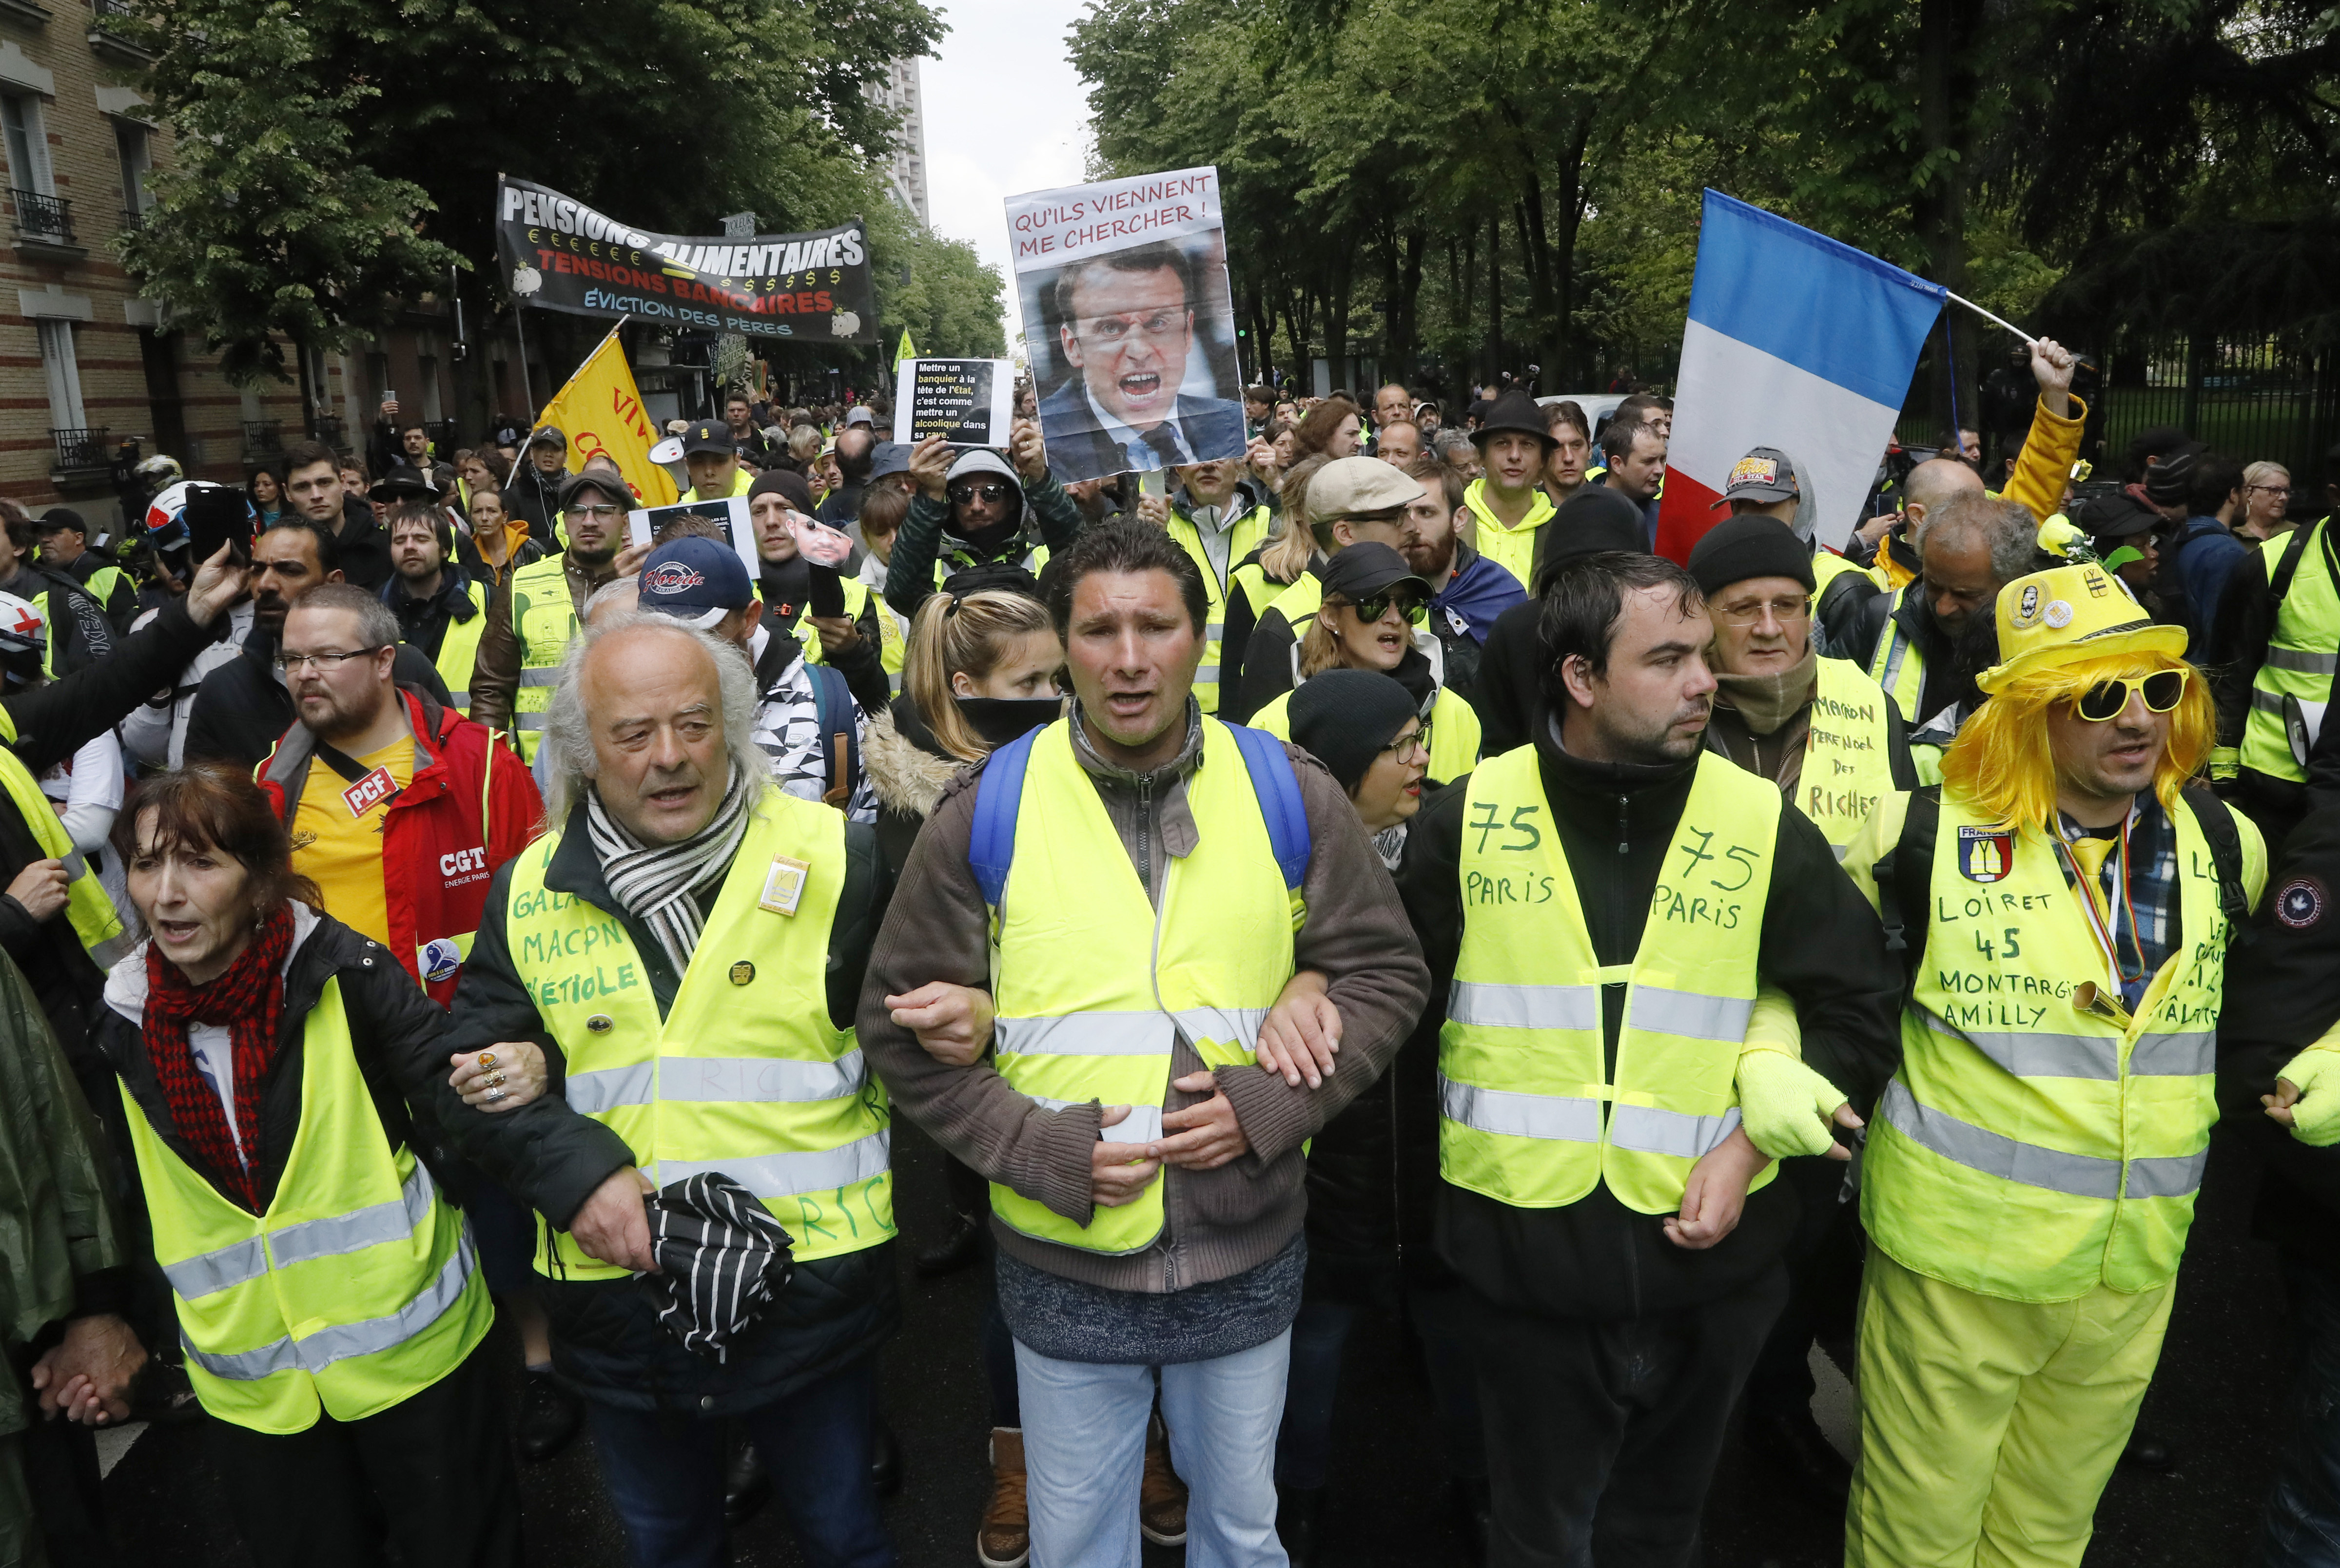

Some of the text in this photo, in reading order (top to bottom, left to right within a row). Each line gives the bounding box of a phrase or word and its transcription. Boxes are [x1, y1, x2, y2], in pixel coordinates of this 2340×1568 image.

[1015, 175, 1211, 232] QU'ILS VIENNENT
[503, 187, 864, 276] PENSIONS ALIMENTAIRES
[726, 214, 755, 231] VOLEURS
[1020, 235, 1054, 257] ME
[1064, 205, 1193, 249] CHERCHER
[538, 249, 833, 315] TENSIONS BANCAIRES
[584, 288, 793, 336] ÉVICTION DES PÈRES
[918, 375, 975, 385] banquier à la
[919, 364, 946, 372] Mettre
[916, 397, 936, 406] c'est
[917, 386, 933, 394] tête
[935, 386, 947, 394] de
[915, 419, 986, 430] alcoolique dans
[916, 408, 943, 417] mettre
[644, 571, 705, 593] Florida
[1813, 696, 1874, 724] MACRON
[349, 774, 386, 810] PCF
[1809, 785, 1878, 821] RICHES
[1469, 802, 1541, 854] 75
[440, 847, 485, 876] CGT
[1680, 826, 1760, 892] 75
[445, 871, 490, 889] ENERGIE PARIS
[1975, 928, 2021, 962] 45
[798, 1176, 892, 1246] RIC
